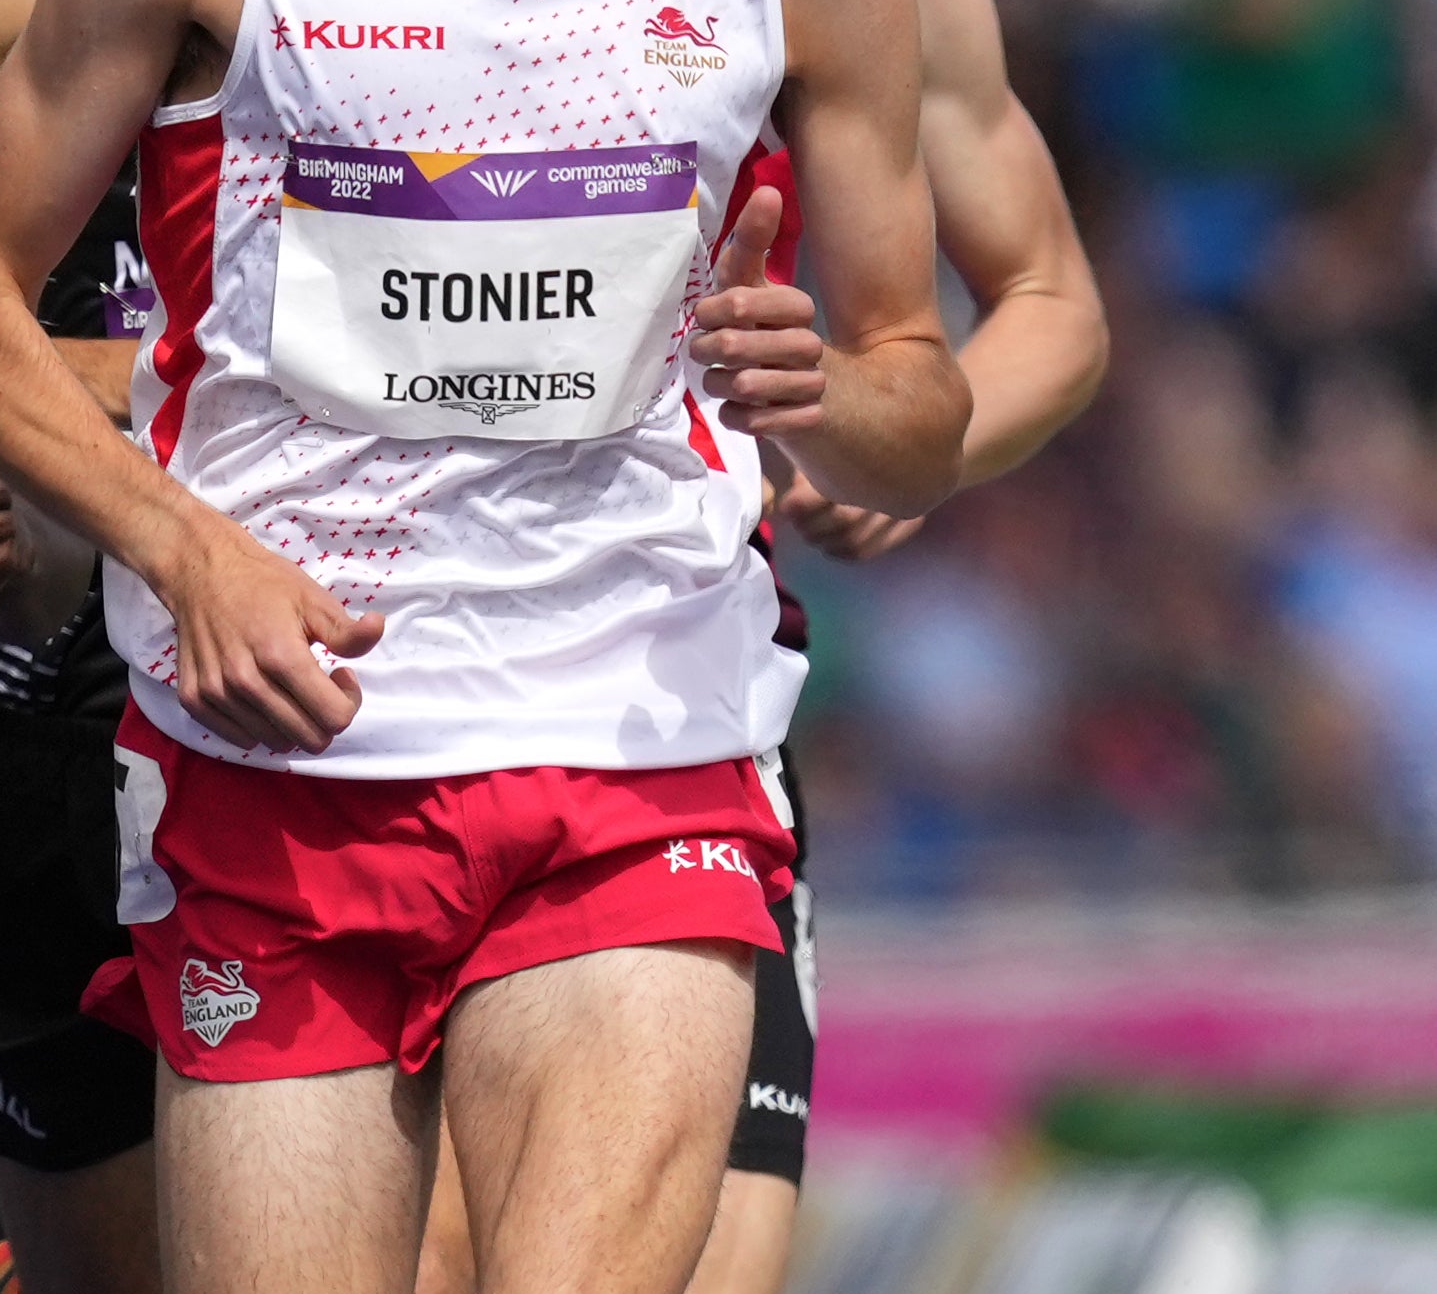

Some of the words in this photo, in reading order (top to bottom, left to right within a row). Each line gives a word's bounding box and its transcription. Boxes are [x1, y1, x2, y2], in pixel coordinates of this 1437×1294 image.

[302, 19, 446, 51] KUKRI
[654, 39, 687, 51] TEAM
[644, 48, 727, 70] ENGLAND
[298, 158, 405, 186] BIRMINGHAM
[547, 158, 682, 184] commonwealth
[330, 179, 373, 200] 2022
[585, 177, 648, 200] games
[381, 269, 597, 323] STONIER
[383, 372, 597, 403] LONGINES
[185, 1001, 253, 1026] ENGLAND
[188, 997, 209, 1009] TEAM
